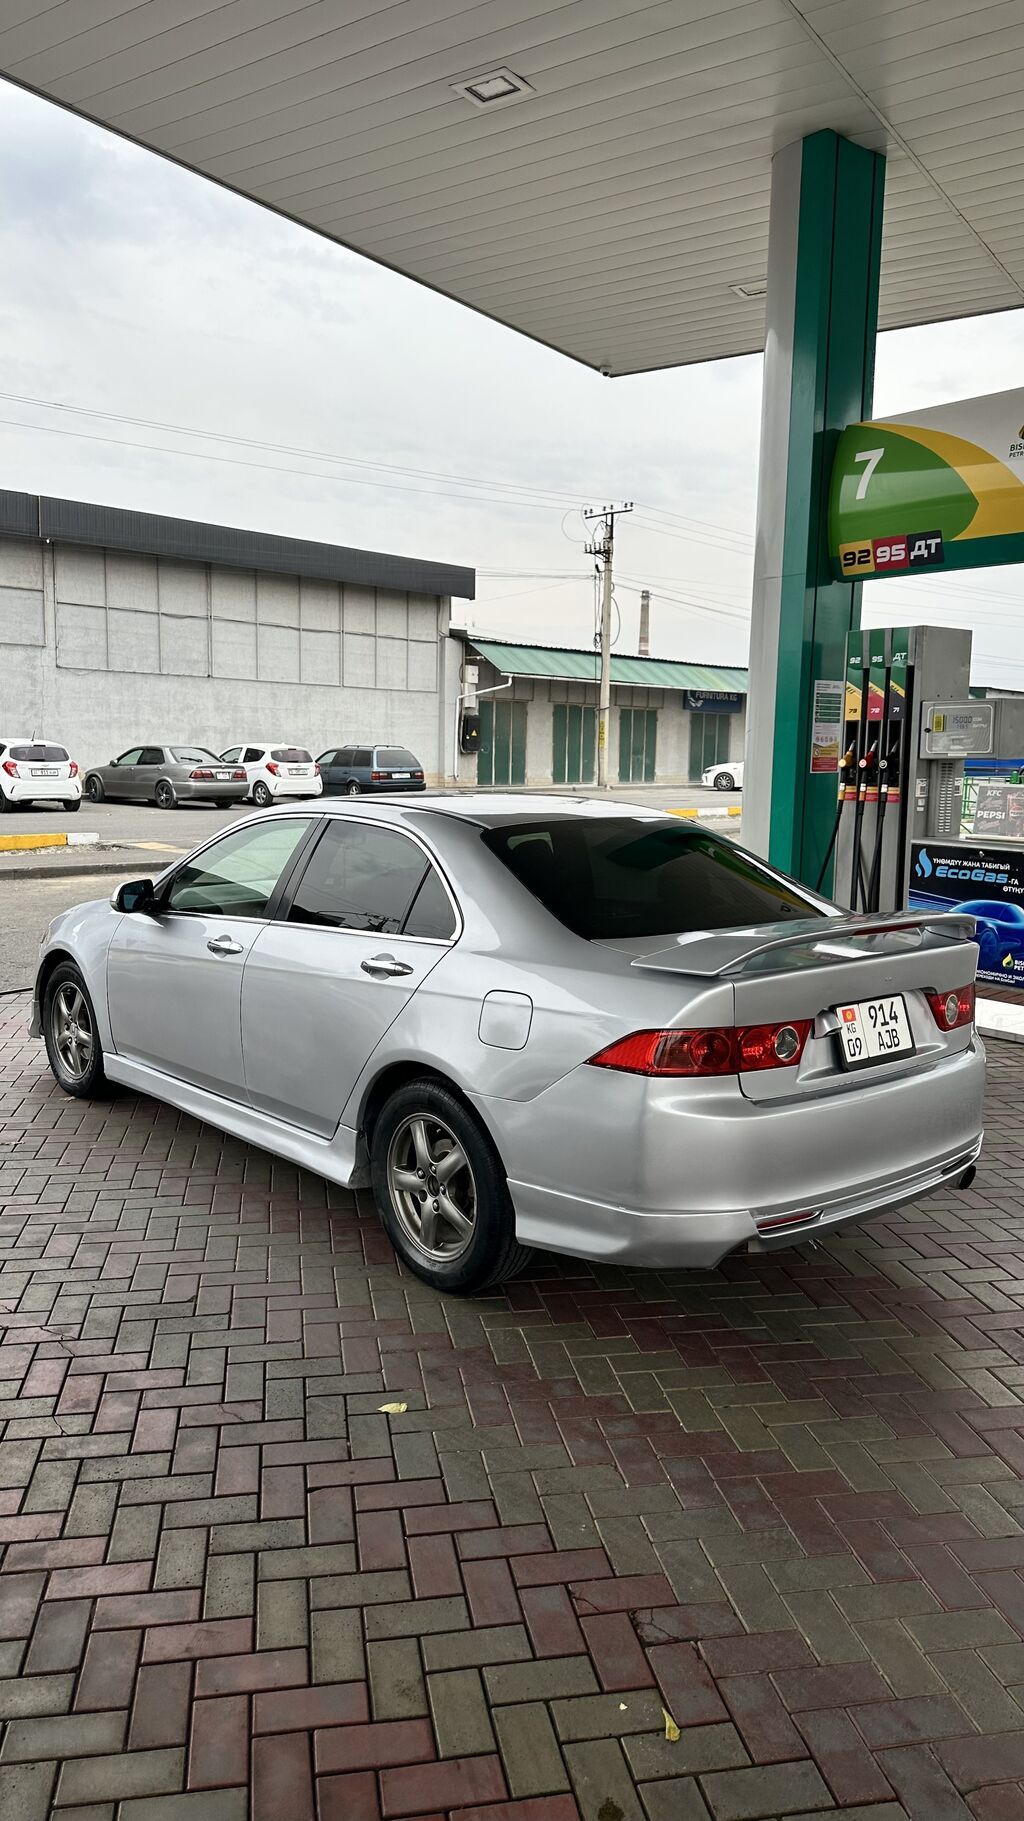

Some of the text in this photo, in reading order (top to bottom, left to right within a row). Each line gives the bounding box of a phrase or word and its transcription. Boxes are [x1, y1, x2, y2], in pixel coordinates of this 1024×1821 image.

[1010, 443, 1024, 451] BIS
[855, 448, 885, 500] 7
[843, 538, 941, 567] 92 95 ДТ
[849, 656, 861, 664] 92
[871, 655, 883, 663] 95
[892, 652, 907, 662] ДТ
[986, 789, 1003, 797] KFC
[976, 810, 1006, 820] PEPSI
[962, 860, 981, 868] ЖАНА
[935, 866, 1008, 884] EcoGas
[868, 1001, 898, 1028] 914
[846, 1022, 857, 1034] KG
[878, 1028, 900, 1051] AJB
[847, 1037, 862, 1057] 09
